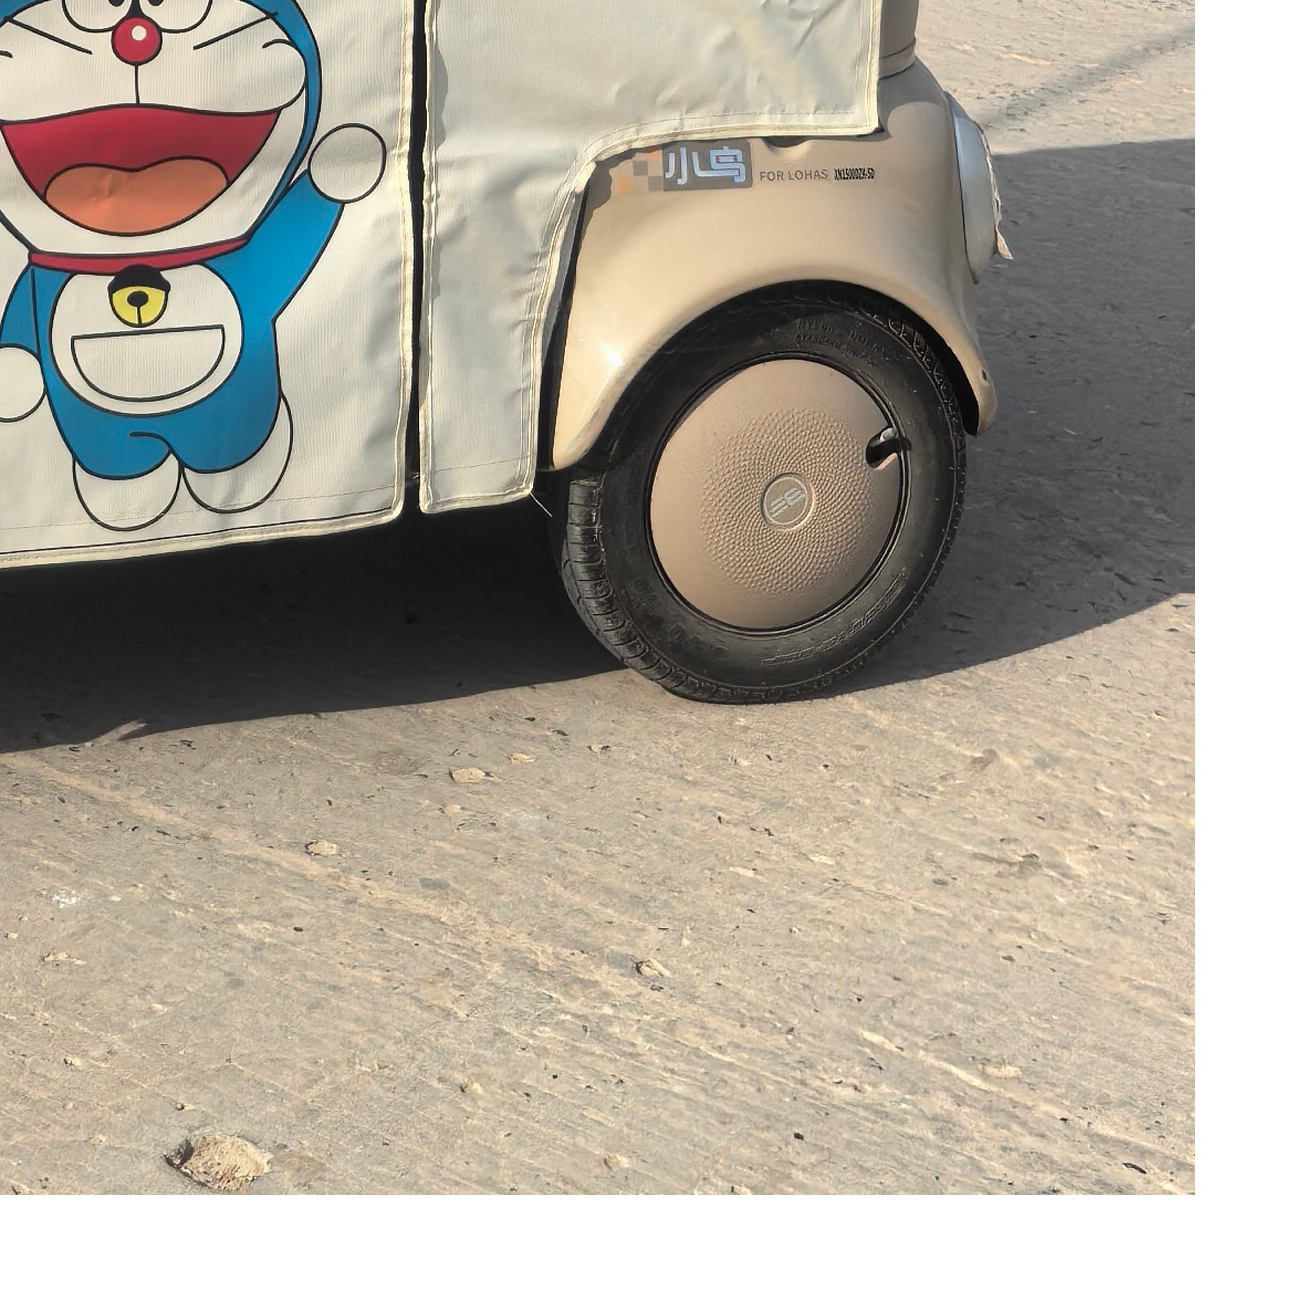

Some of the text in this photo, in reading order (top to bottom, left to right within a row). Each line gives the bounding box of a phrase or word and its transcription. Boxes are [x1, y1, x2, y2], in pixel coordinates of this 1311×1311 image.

[665, 146, 746, 185] 小鸟
[759, 169, 784, 182] FOR
[788, 169, 828, 181] LOHAS
